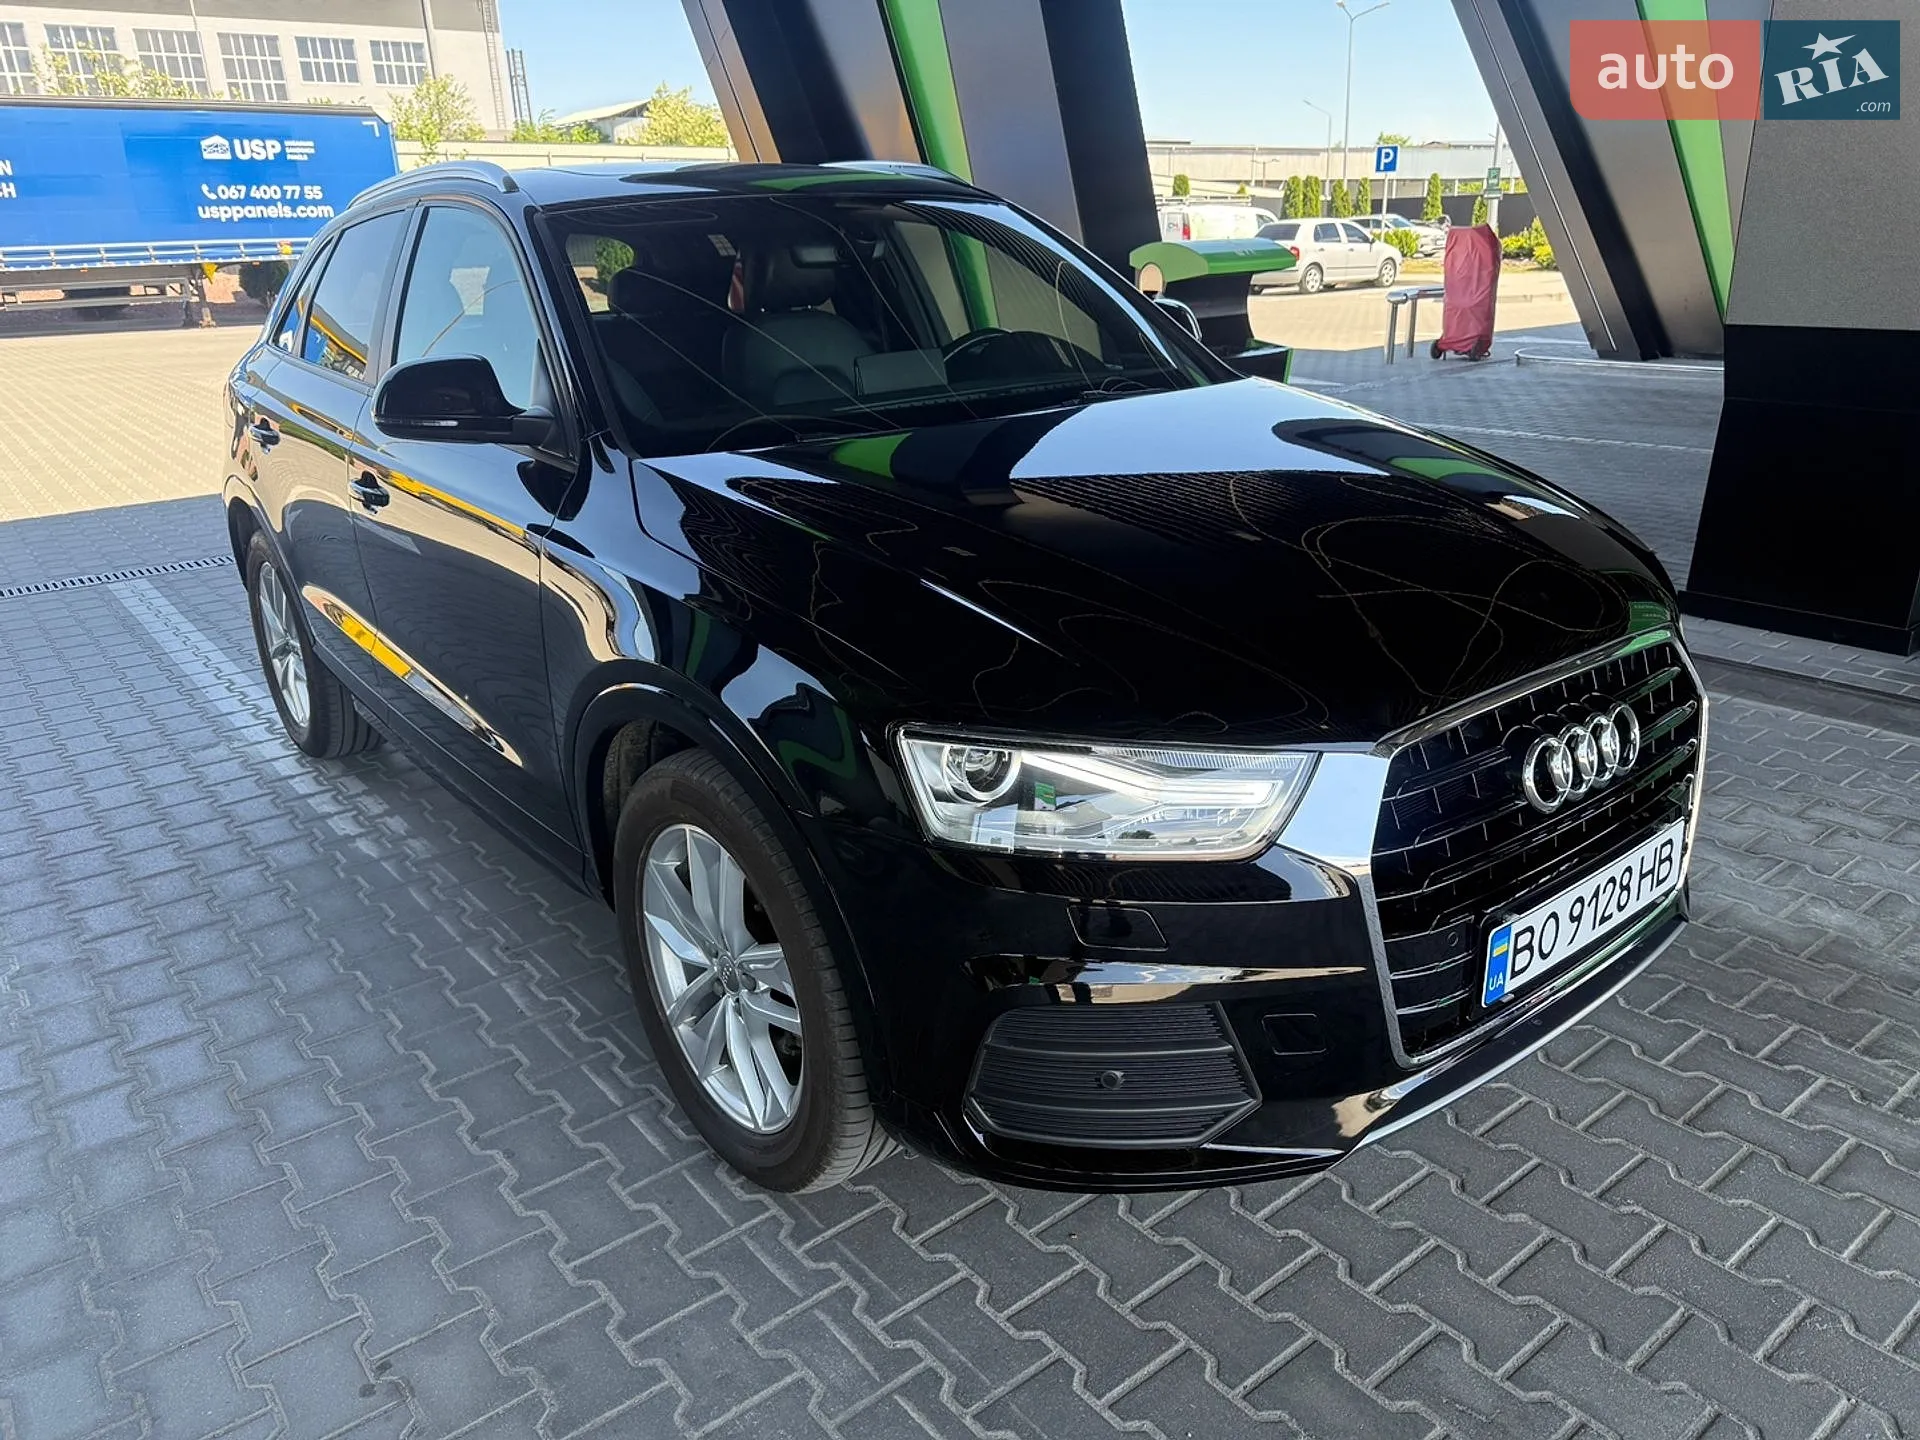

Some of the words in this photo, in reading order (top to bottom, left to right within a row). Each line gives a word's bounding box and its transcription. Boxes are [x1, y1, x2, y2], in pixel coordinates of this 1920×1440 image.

[233, 139, 281, 160] USP
[1380, 149, 1394, 170] P
[217, 185, 247, 200] 067
[250, 185, 281, 200] 400
[283, 185, 301, 200] 77
[304, 185, 323, 200] 55
[198, 201, 335, 223] usppanels.com
[1510, 911, 1560, 980] BO
[1567, 865, 1633, 947] 9128
[1637, 838, 1674, 901] HB
[1489, 972, 1504, 990] UA
